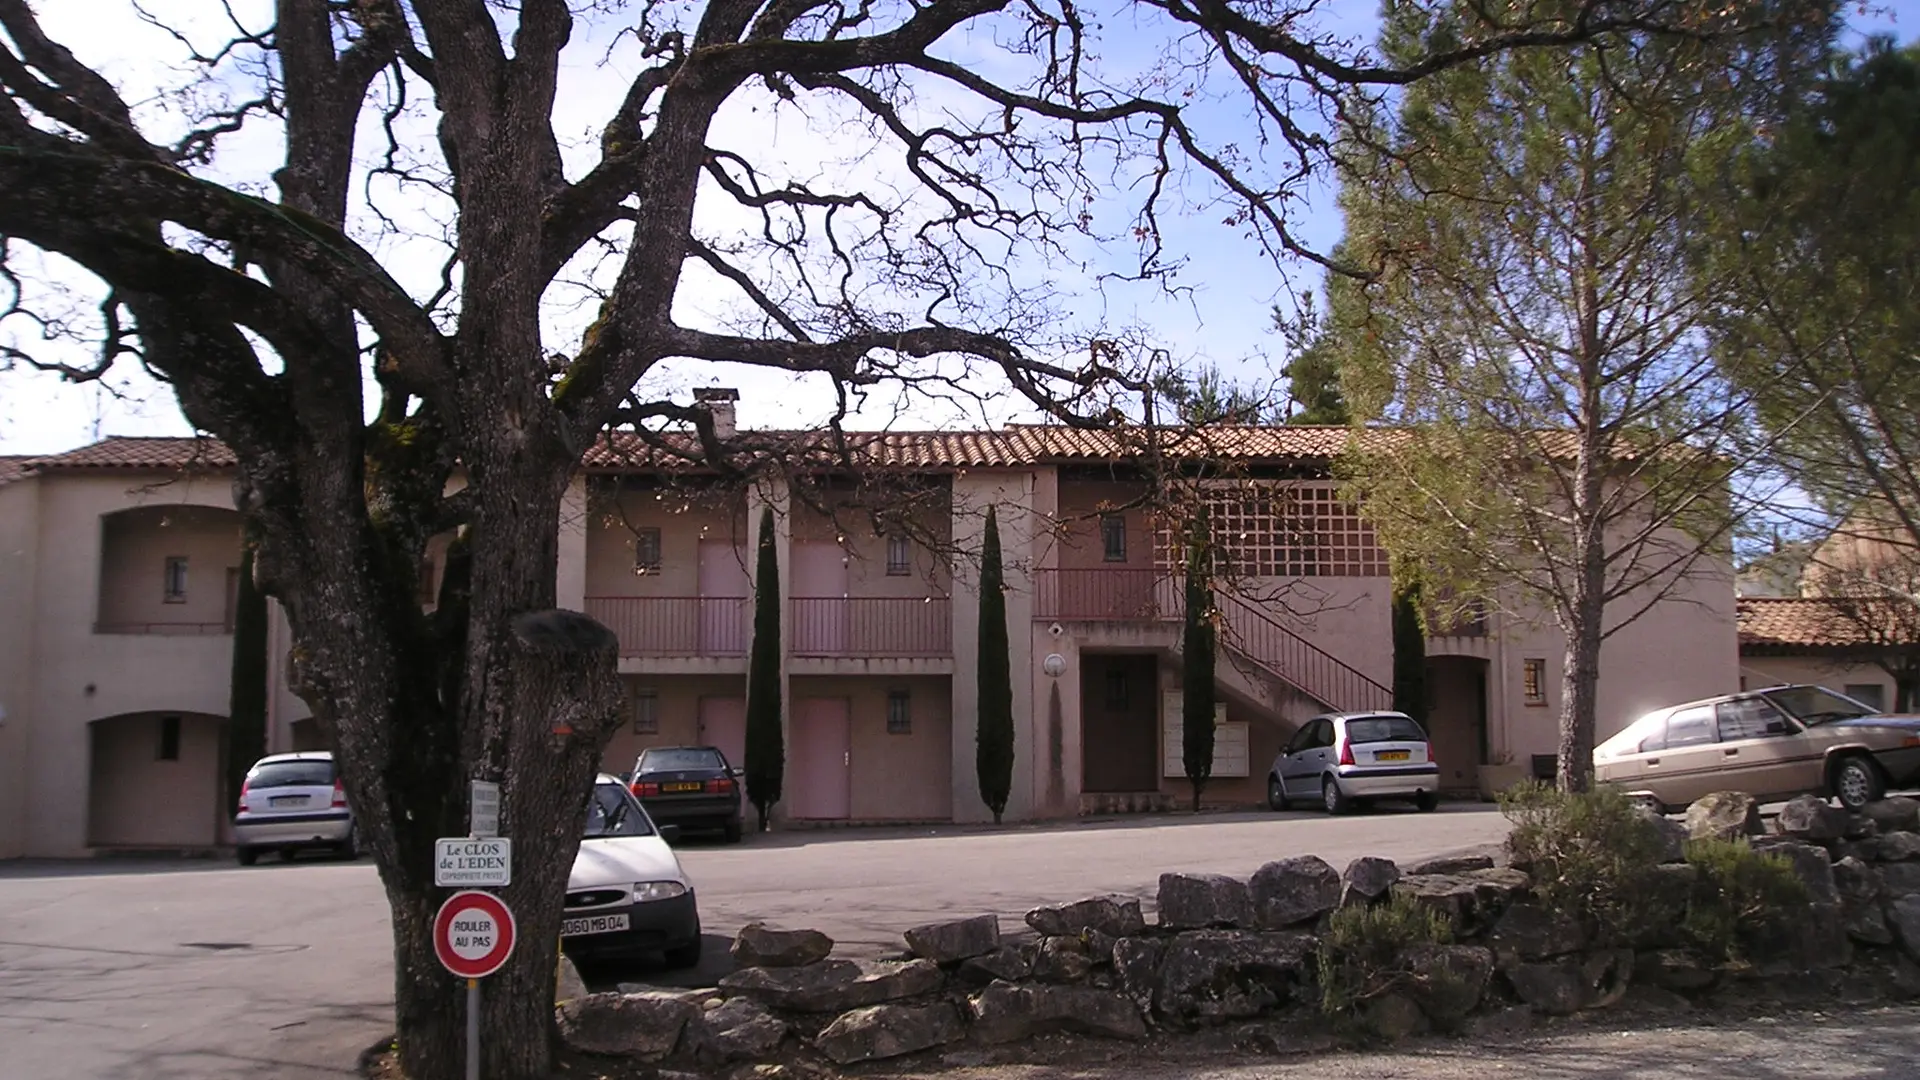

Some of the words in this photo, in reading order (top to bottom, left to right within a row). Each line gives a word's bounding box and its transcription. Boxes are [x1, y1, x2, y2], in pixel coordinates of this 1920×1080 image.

[446, 844, 460, 856] Le
[464, 844, 500, 856] CLOS
[439, 858, 453, 869] de
[458, 857, 505, 869] L'EDEN
[454, 921, 491, 932] ROULER
[591, 918, 606, 932] MB
[608, 916, 624, 930] 04
[454, 937, 468, 947] AU
[472, 936, 490, 947] PAS
